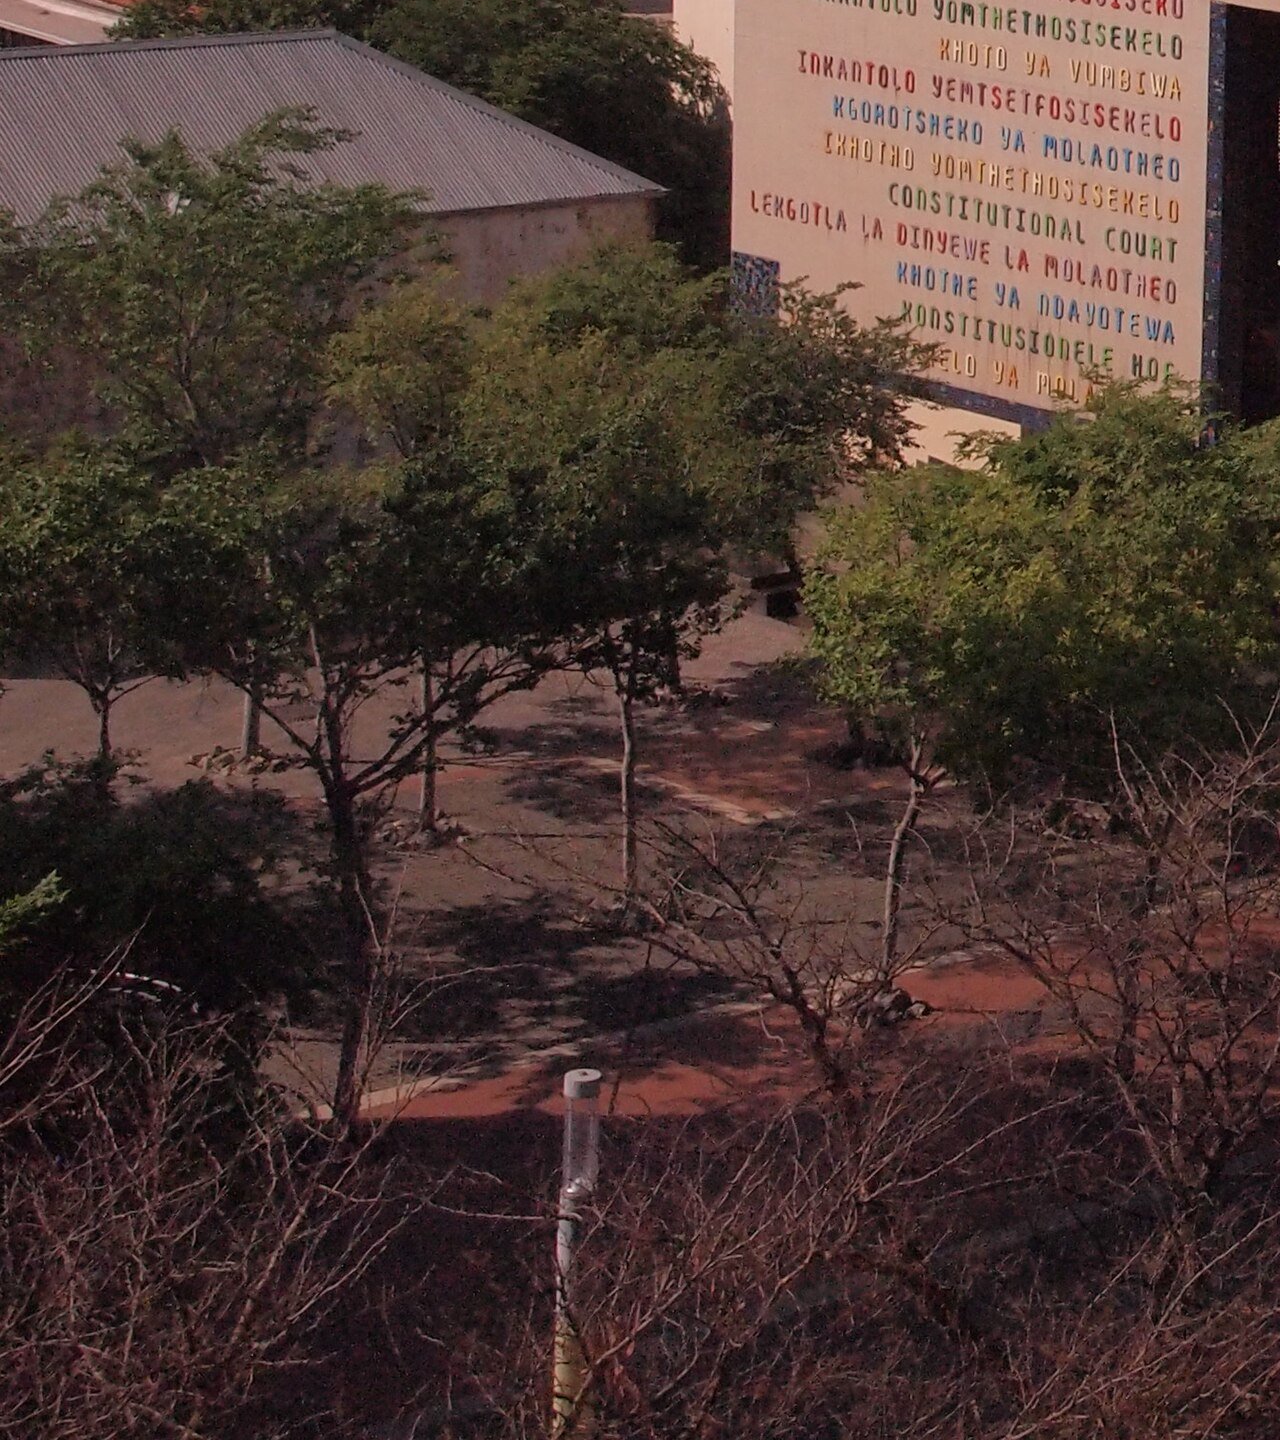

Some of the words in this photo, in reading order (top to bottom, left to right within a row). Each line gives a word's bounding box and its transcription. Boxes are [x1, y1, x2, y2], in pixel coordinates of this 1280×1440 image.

[798, 49, 916, 94] INKANTOLO
[932, 73, 1182, 142] YEMTSETFOSISEKELO
[1026, 51, 1051, 78] YA
[1069, 58, 1182, 103] VUMBIWA
[823, 130, 915, 172] IKHOTHO
[931, 152, 1180, 224] YOMTHETHOSISEKELO
[833, 95, 983, 145] KGOROTSHEKO
[1002, 125, 1026, 154] YA
[1042, 133, 1181, 183] MOLAOTHEO
[750, 189, 848, 233] LEKGOTLA
[862, 214, 884, 241] LA
[897, 221, 991, 265] DINYEWE
[1005, 244, 1030, 273] LA
[1043, 253, 1177, 305] MOLAOTHEO
[889, 182, 1086, 245] CONSTITUTIONAL
[1105, 226, 1178, 263] COURT
[897, 260, 979, 301] KHOTHE
[995, 281, 1021, 310] YA
[901, 299, 1114, 373] KONSTITUSIONELE
[993, 359, 1019, 390] YA
